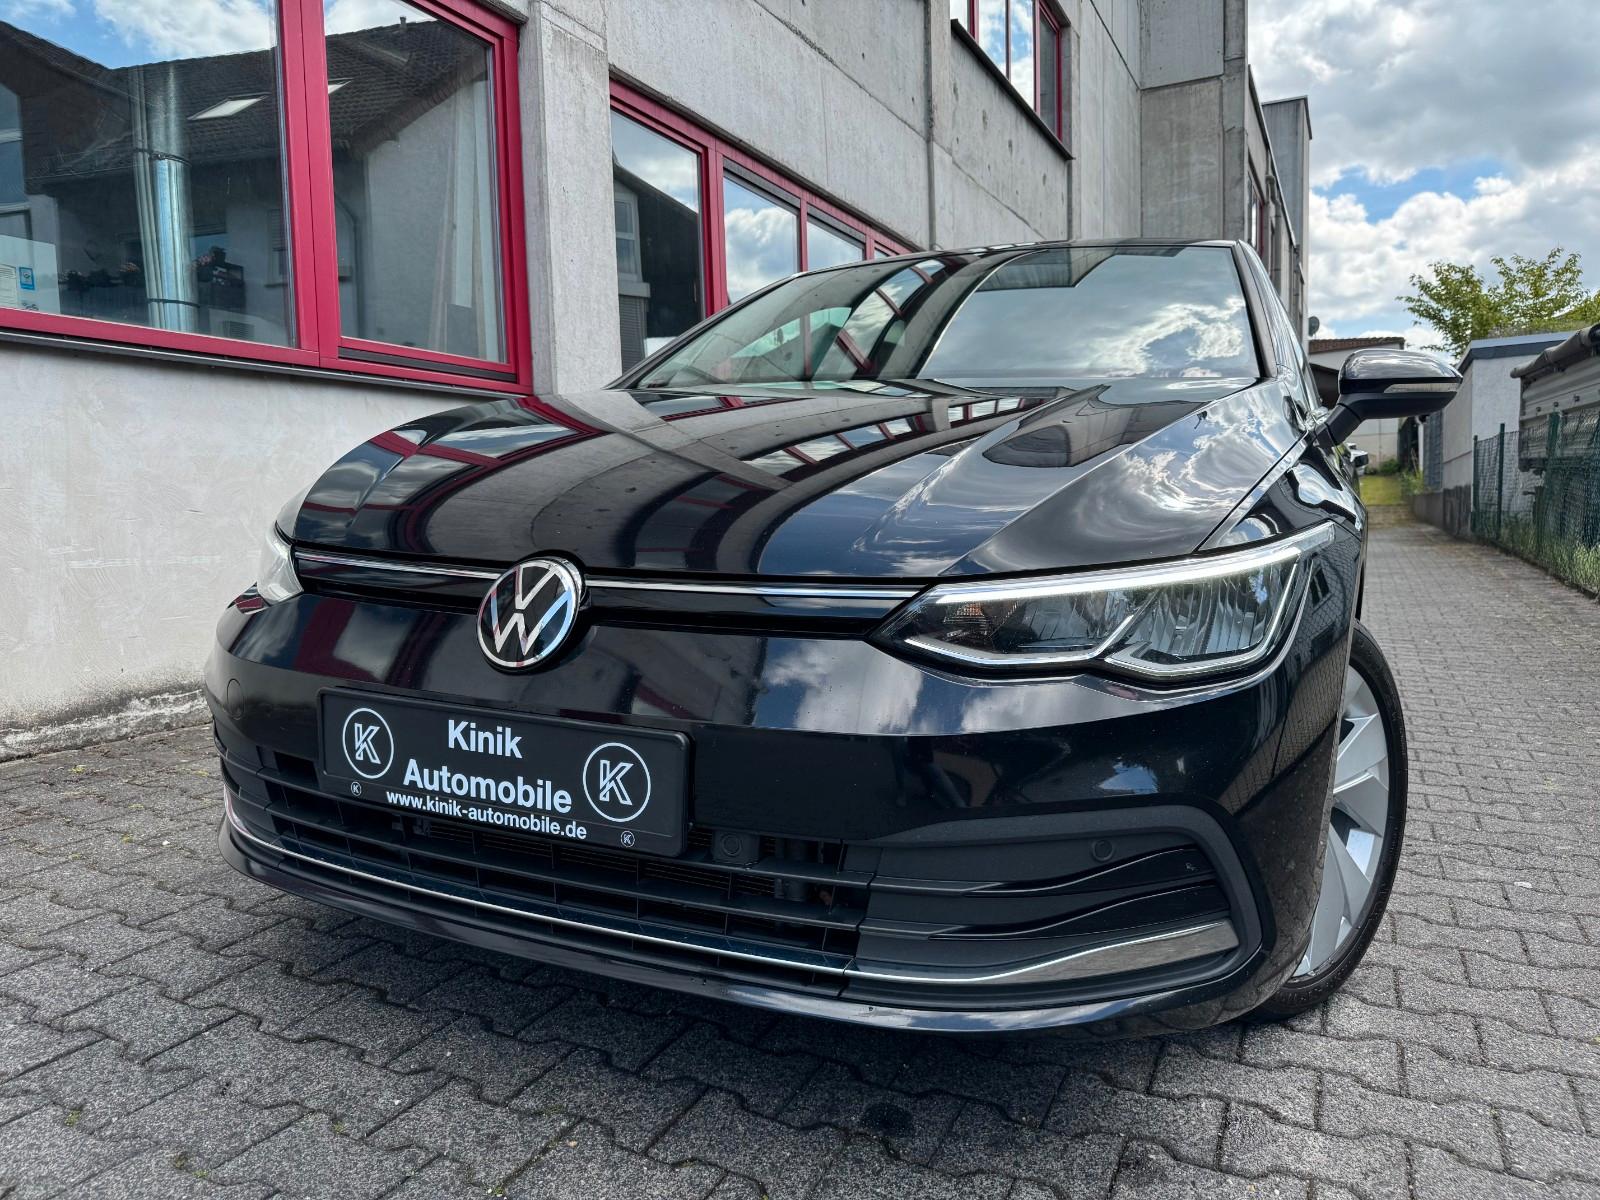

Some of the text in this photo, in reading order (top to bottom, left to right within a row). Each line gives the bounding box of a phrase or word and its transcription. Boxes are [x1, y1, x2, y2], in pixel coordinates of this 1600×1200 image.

[490, 565, 572, 656] VW
[354, 722, 382, 765] K
[448, 719, 523, 759] Kinik
[403, 758, 572, 814] Automobile
[600, 759, 634, 806] K
[386, 790, 587, 840] www.kinik-automobile.de
